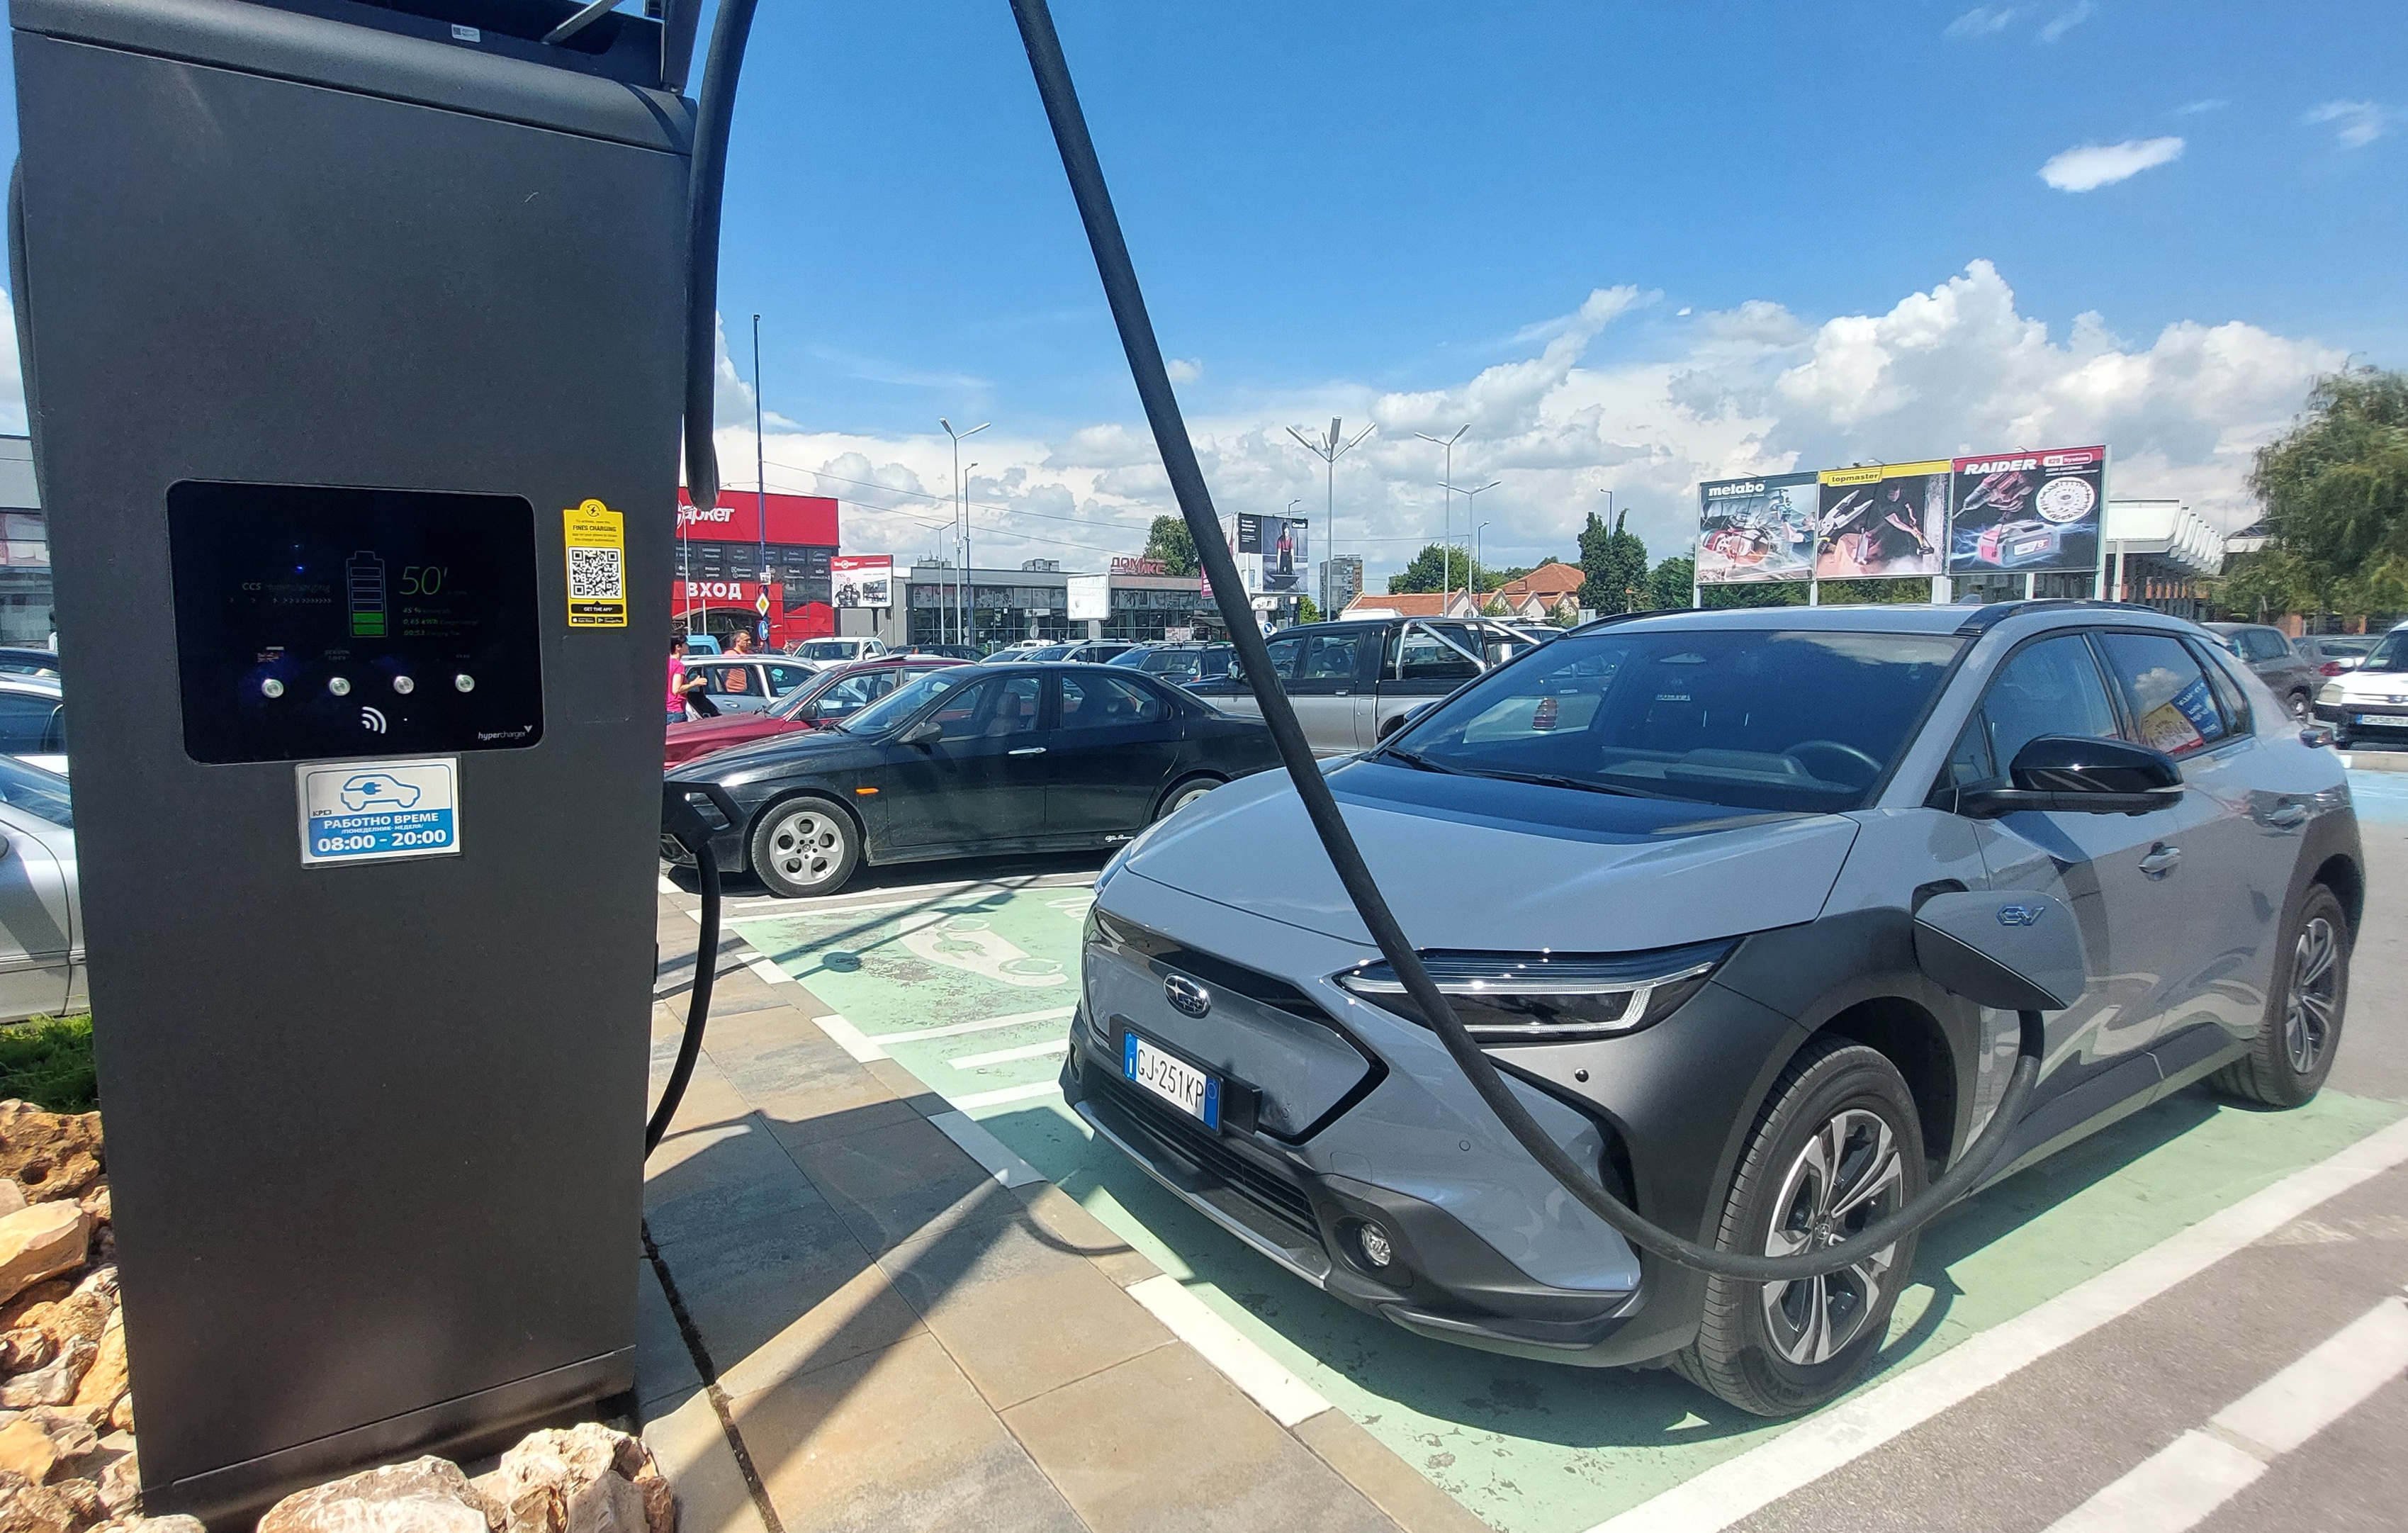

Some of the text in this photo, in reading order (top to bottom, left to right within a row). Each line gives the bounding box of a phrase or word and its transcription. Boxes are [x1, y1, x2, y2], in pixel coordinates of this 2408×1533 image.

[1964, 459, 2037, 476] RAIDER
[1832, 473, 1878, 483] topmaster
[1708, 482, 1765, 497] metabo
[688, 582, 742, 600] ВХОД
[478, 731, 526, 741] hypercharger
[324, 812, 439, 829] РАБОТНО ВРЕМЕ
[317, 834, 376, 852] 08:00
[391, 829, 446, 846] 20:00
